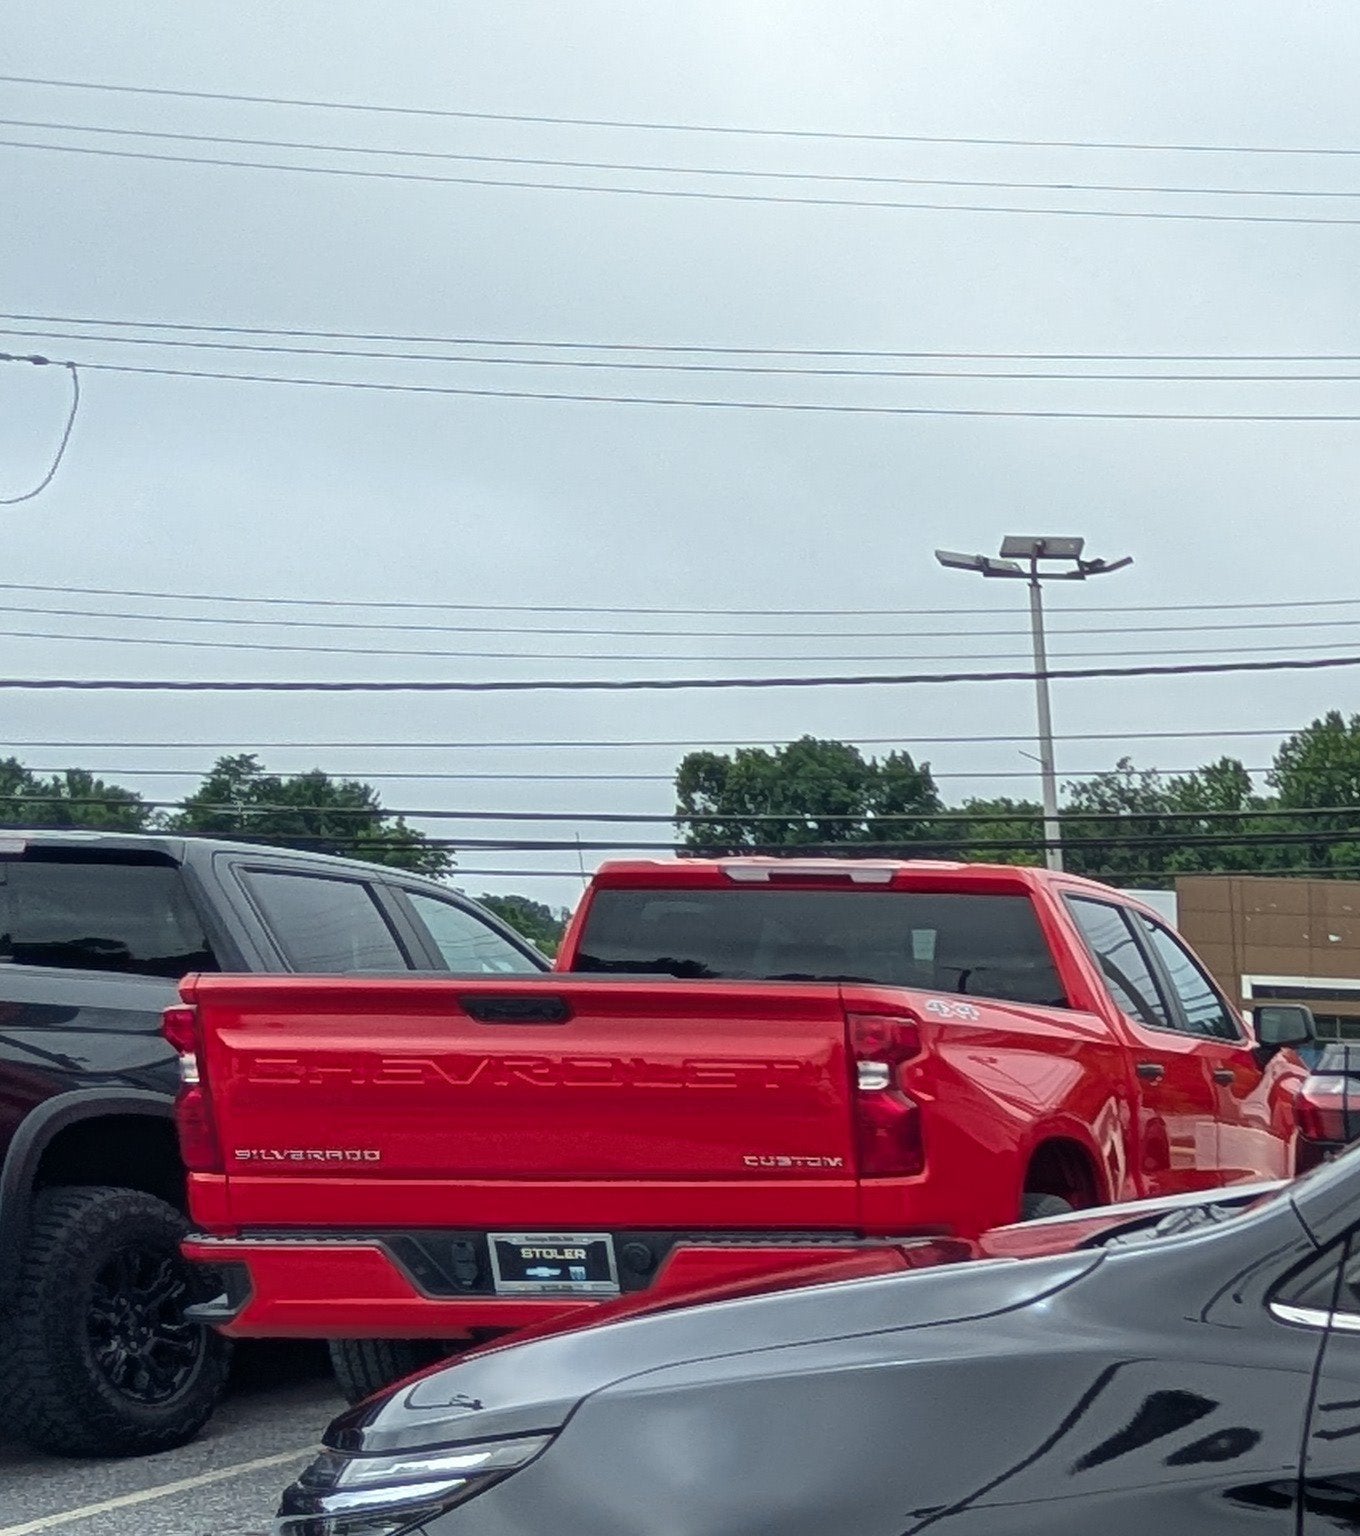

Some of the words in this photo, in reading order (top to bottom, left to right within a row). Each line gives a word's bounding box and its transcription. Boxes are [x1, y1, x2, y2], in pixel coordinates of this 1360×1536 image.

[246, 1058, 802, 1088] CHEVROLET
[234, 1148, 381, 1162] SILVERADO
[743, 1155, 843, 1167] CUSTOM
[520, 1247, 587, 1260] STOLER
